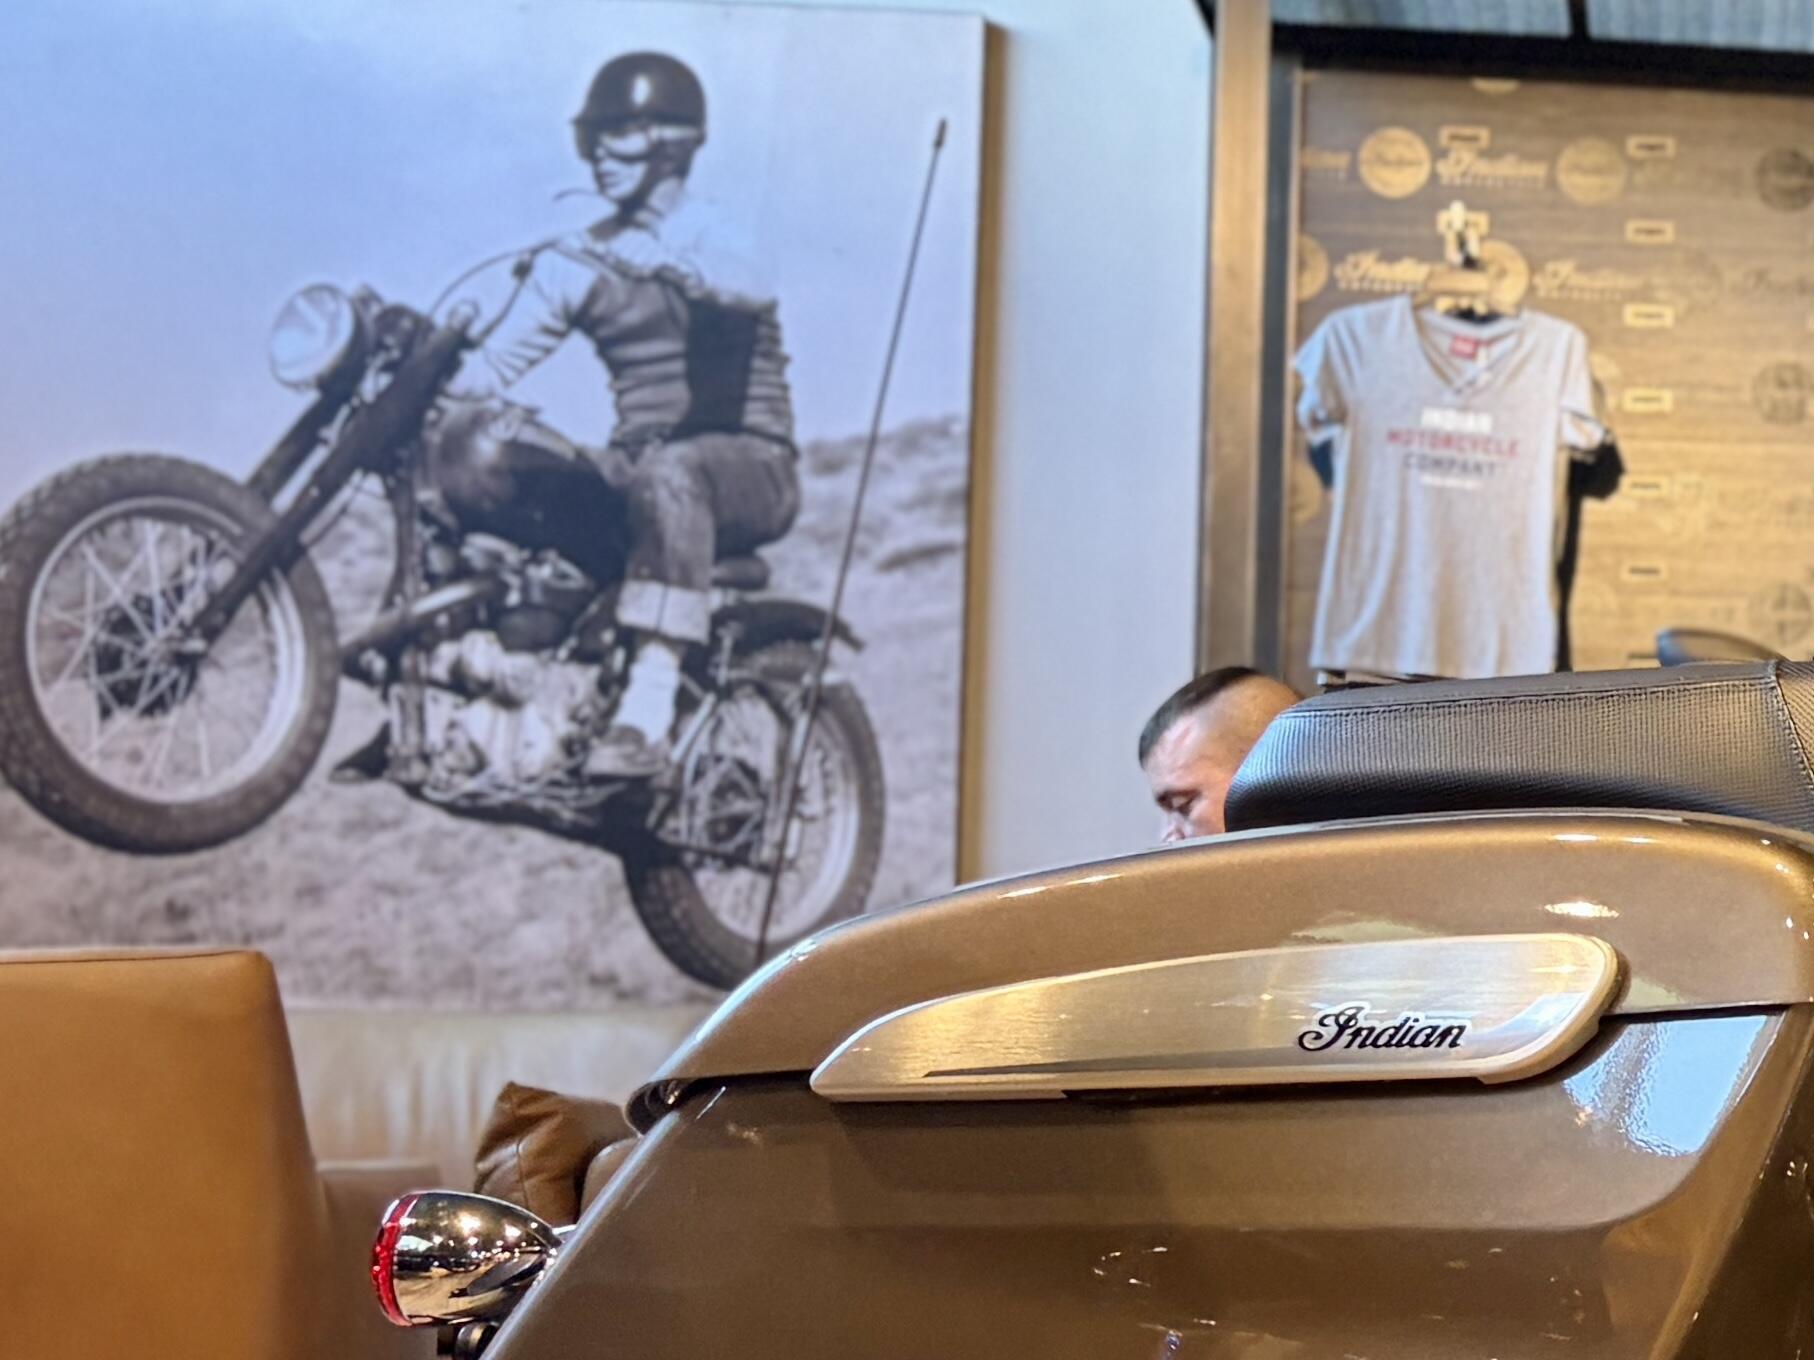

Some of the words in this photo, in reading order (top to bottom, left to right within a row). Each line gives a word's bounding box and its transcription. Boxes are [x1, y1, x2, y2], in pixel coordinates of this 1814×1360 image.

[1386, 428, 1519, 457] MOTORCYCLE
[1403, 452, 1497, 477] COMPANY
[1297, 1004, 1468, 1052] Indian
